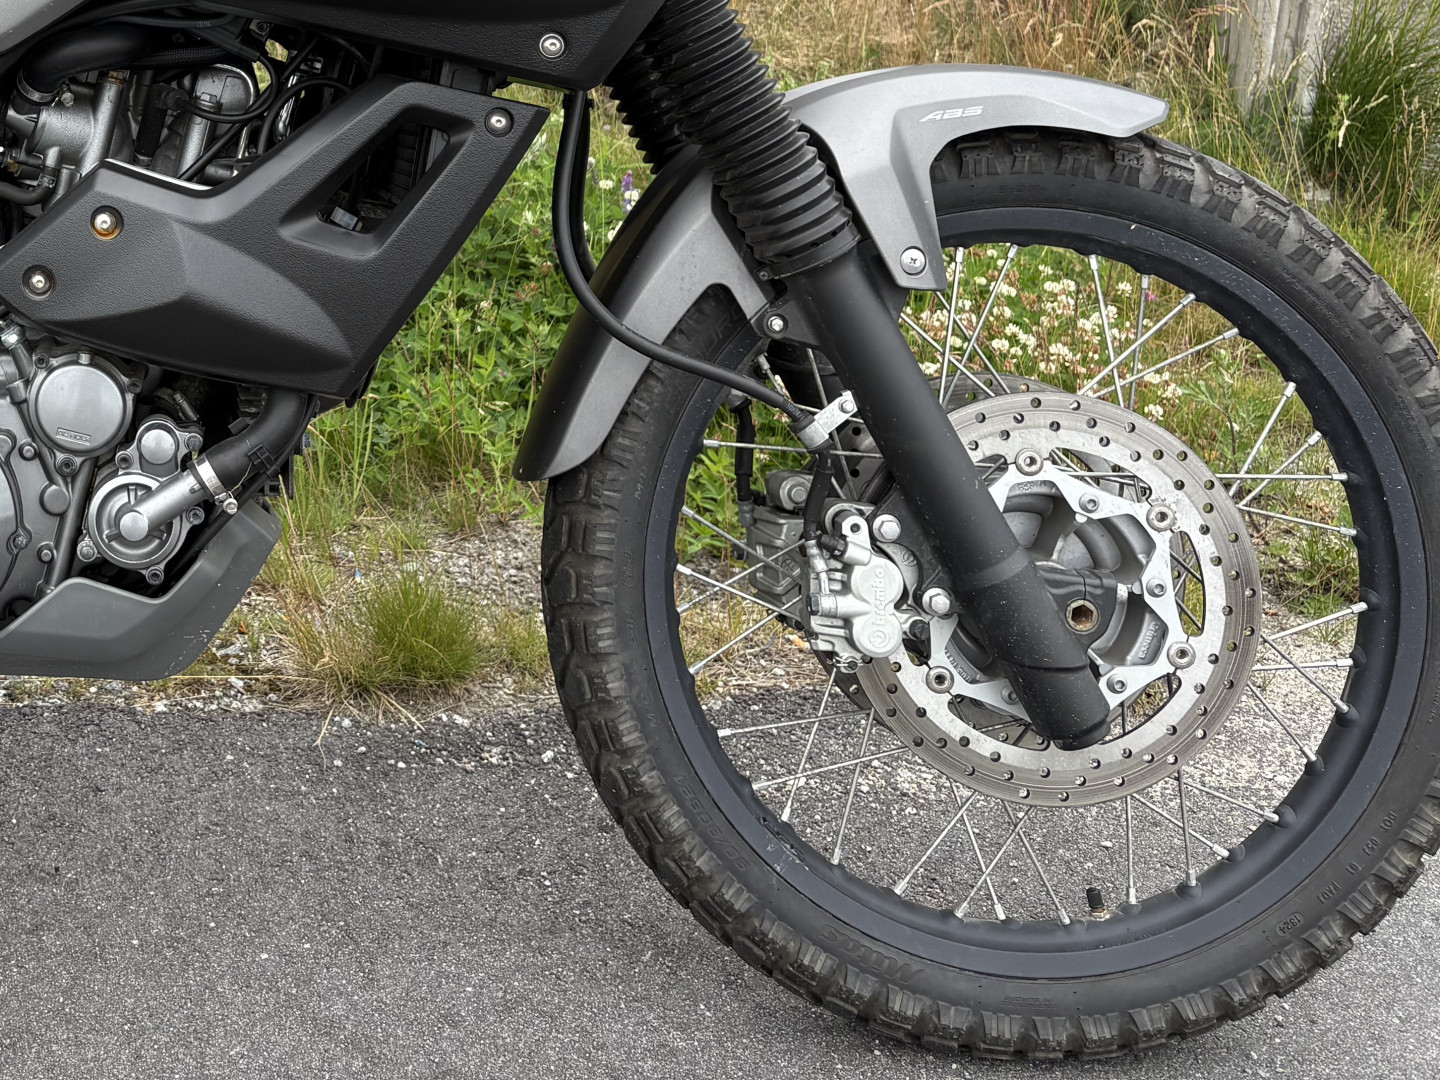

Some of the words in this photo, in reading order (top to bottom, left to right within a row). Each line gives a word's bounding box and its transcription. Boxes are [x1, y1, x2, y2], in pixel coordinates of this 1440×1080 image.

[918, 105, 984, 123] ABS
[872, 567, 886, 626] brembo
[1379, 811, 1398, 833] DOT
[820, 926, 923, 985] Mitas
